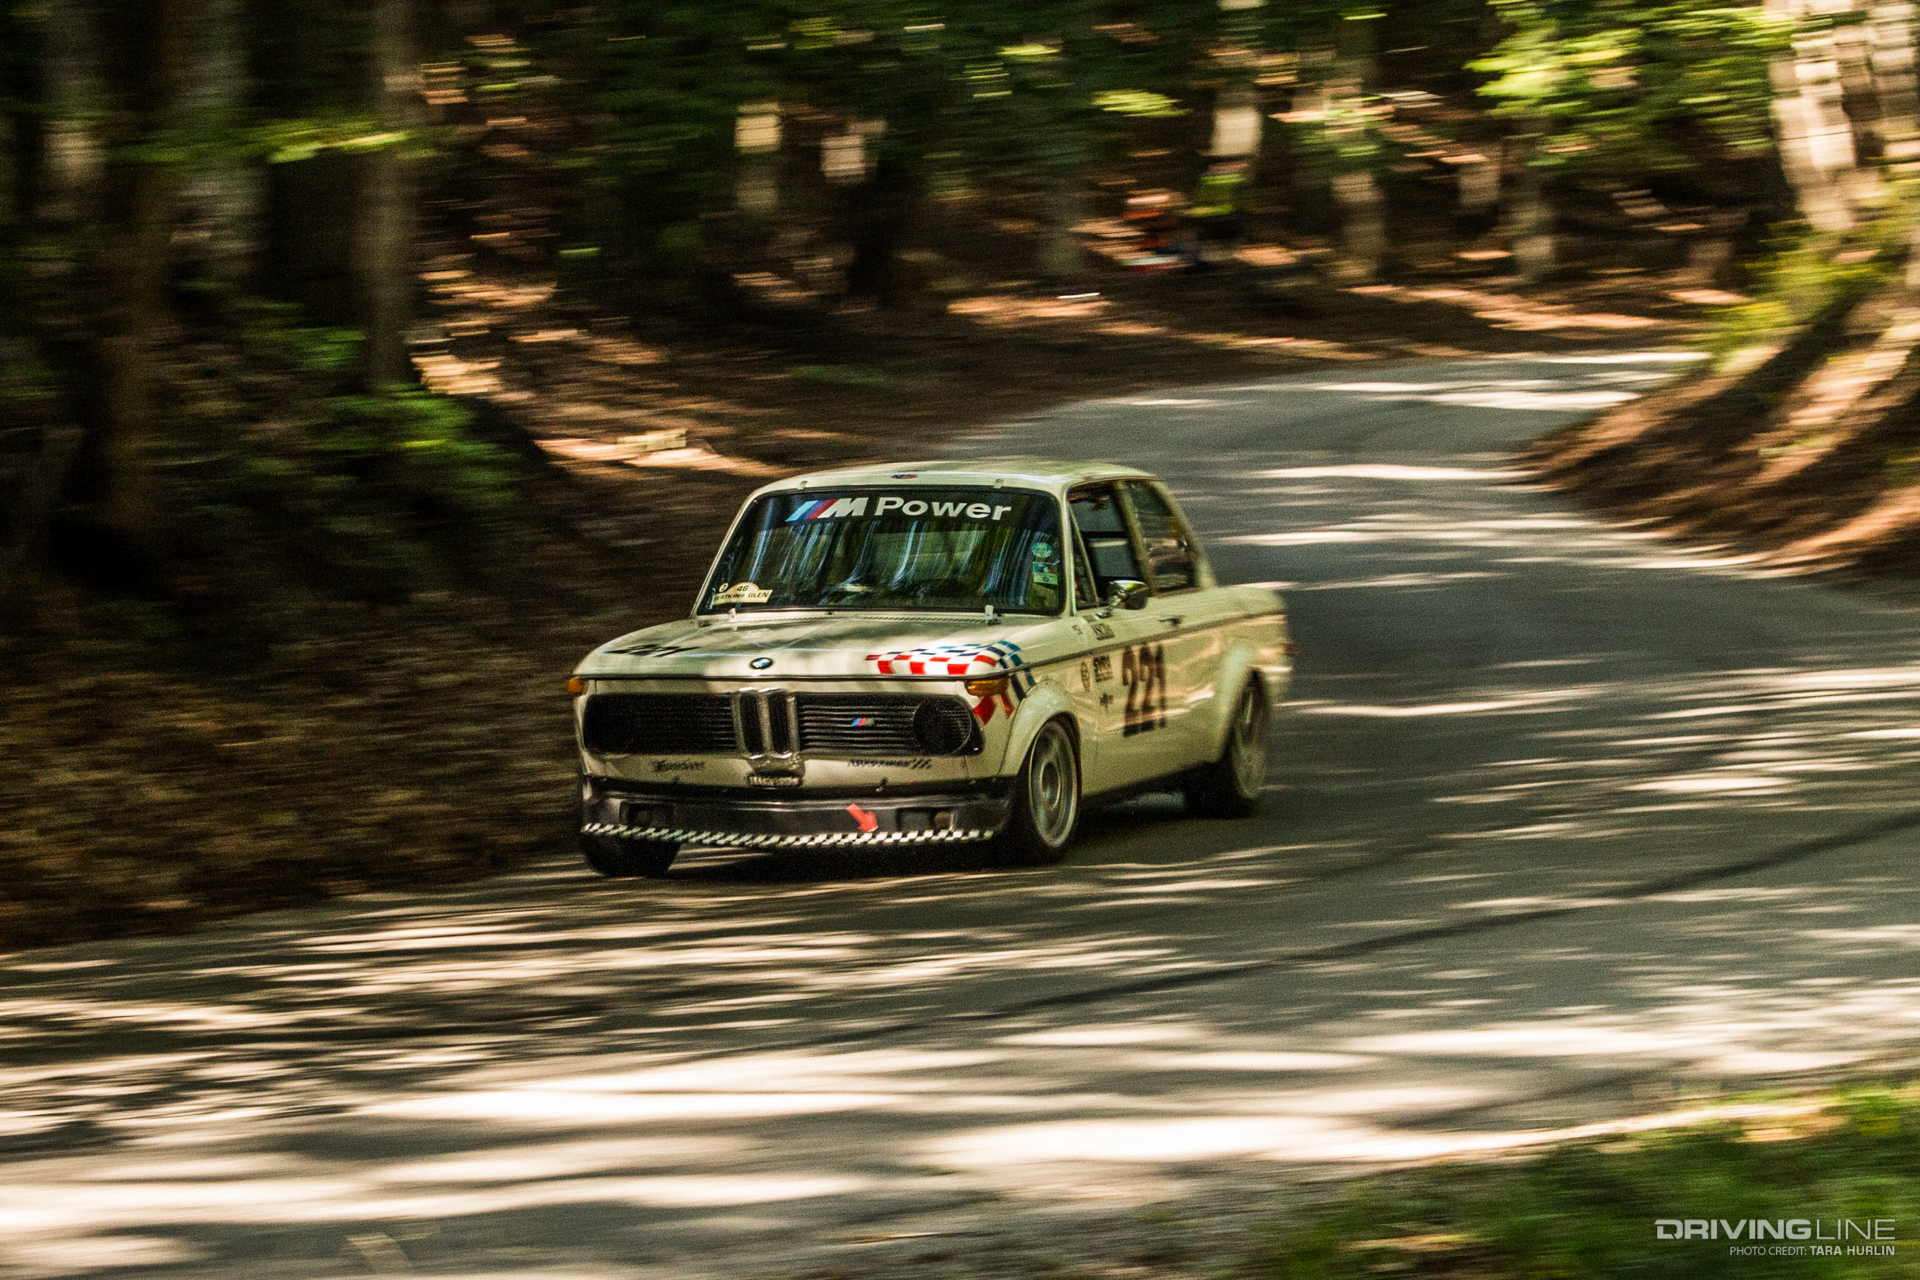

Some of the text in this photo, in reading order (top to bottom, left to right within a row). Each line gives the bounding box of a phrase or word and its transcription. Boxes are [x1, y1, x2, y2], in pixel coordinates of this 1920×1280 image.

[875, 496, 1012, 521] Power
[714, 593, 745, 601] WATKINS
[1121, 643, 1167, 738] 221
